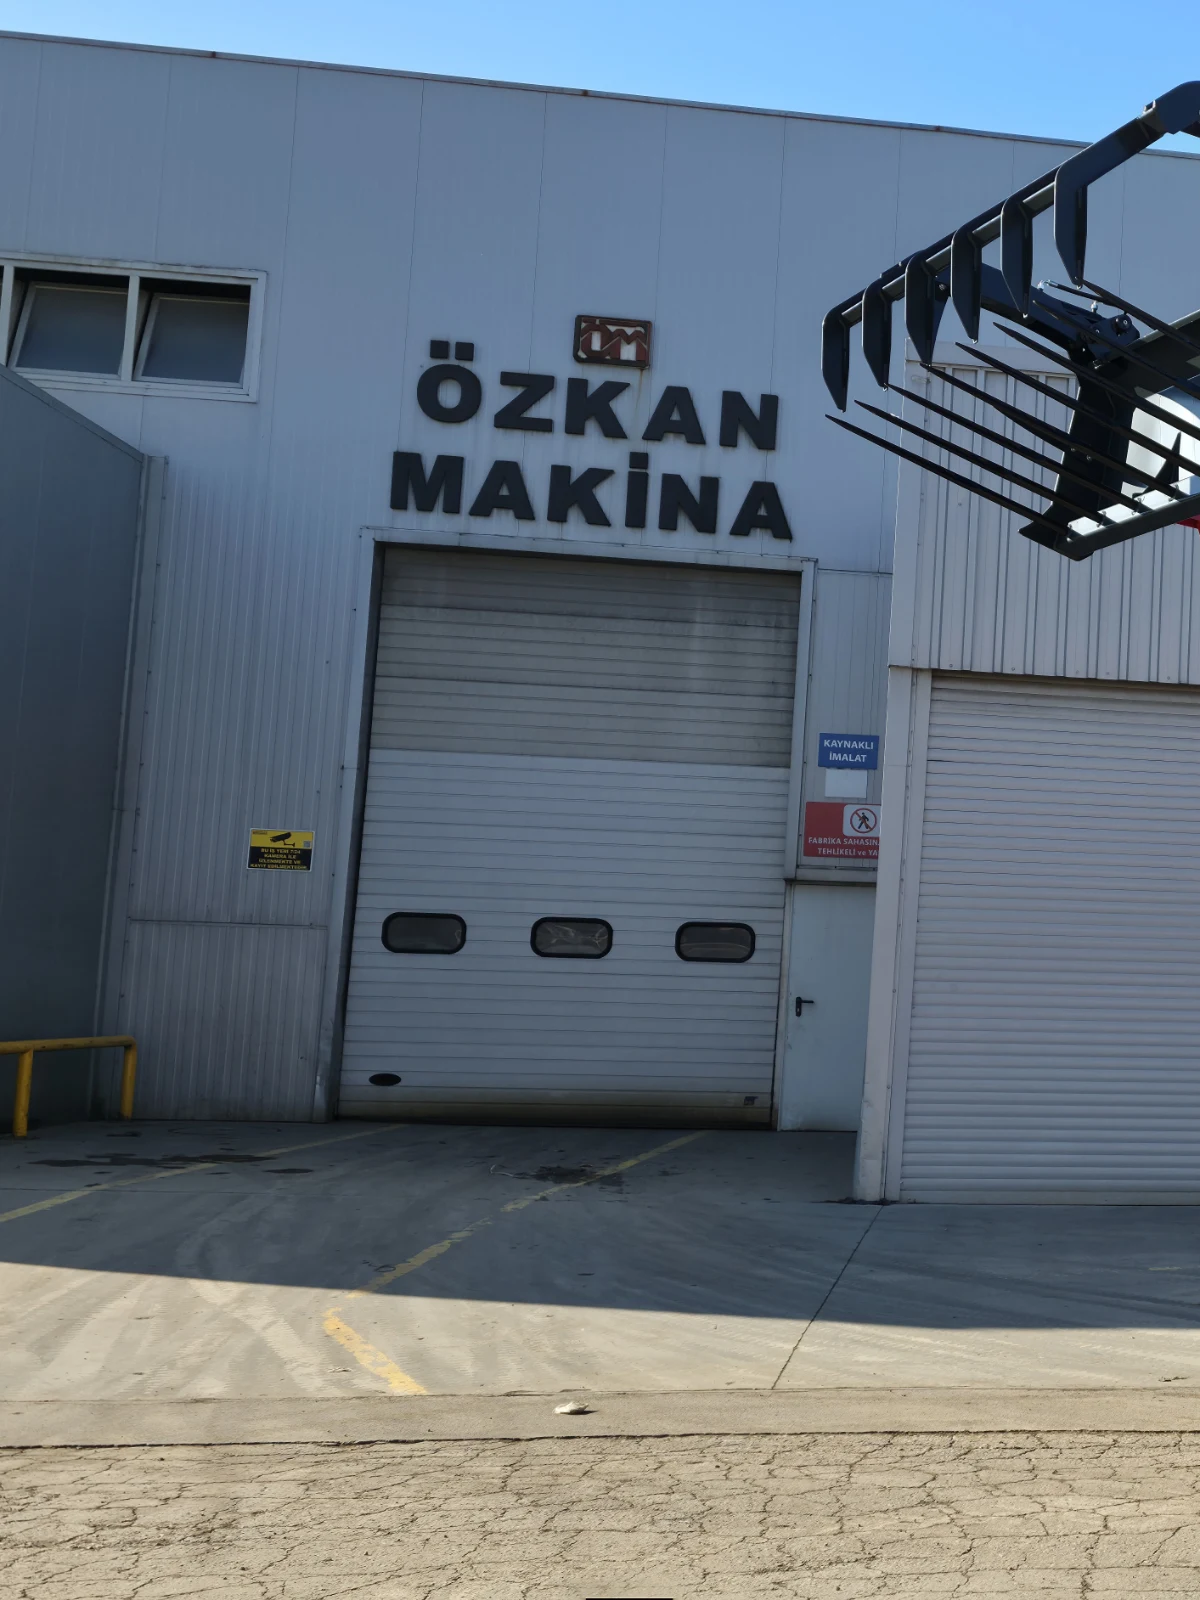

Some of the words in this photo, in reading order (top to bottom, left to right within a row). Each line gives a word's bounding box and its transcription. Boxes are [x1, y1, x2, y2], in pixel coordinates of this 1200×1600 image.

[417, 339, 779, 450] ÖZKAN
[390, 450, 793, 540] MAKİNA
[823, 739, 874, 750] KAYNAKLI
[829, 750, 867, 763] İMALAT
[808, 836, 842, 846] FABRİKA
[843, 837, 880, 847] SAHASIN
